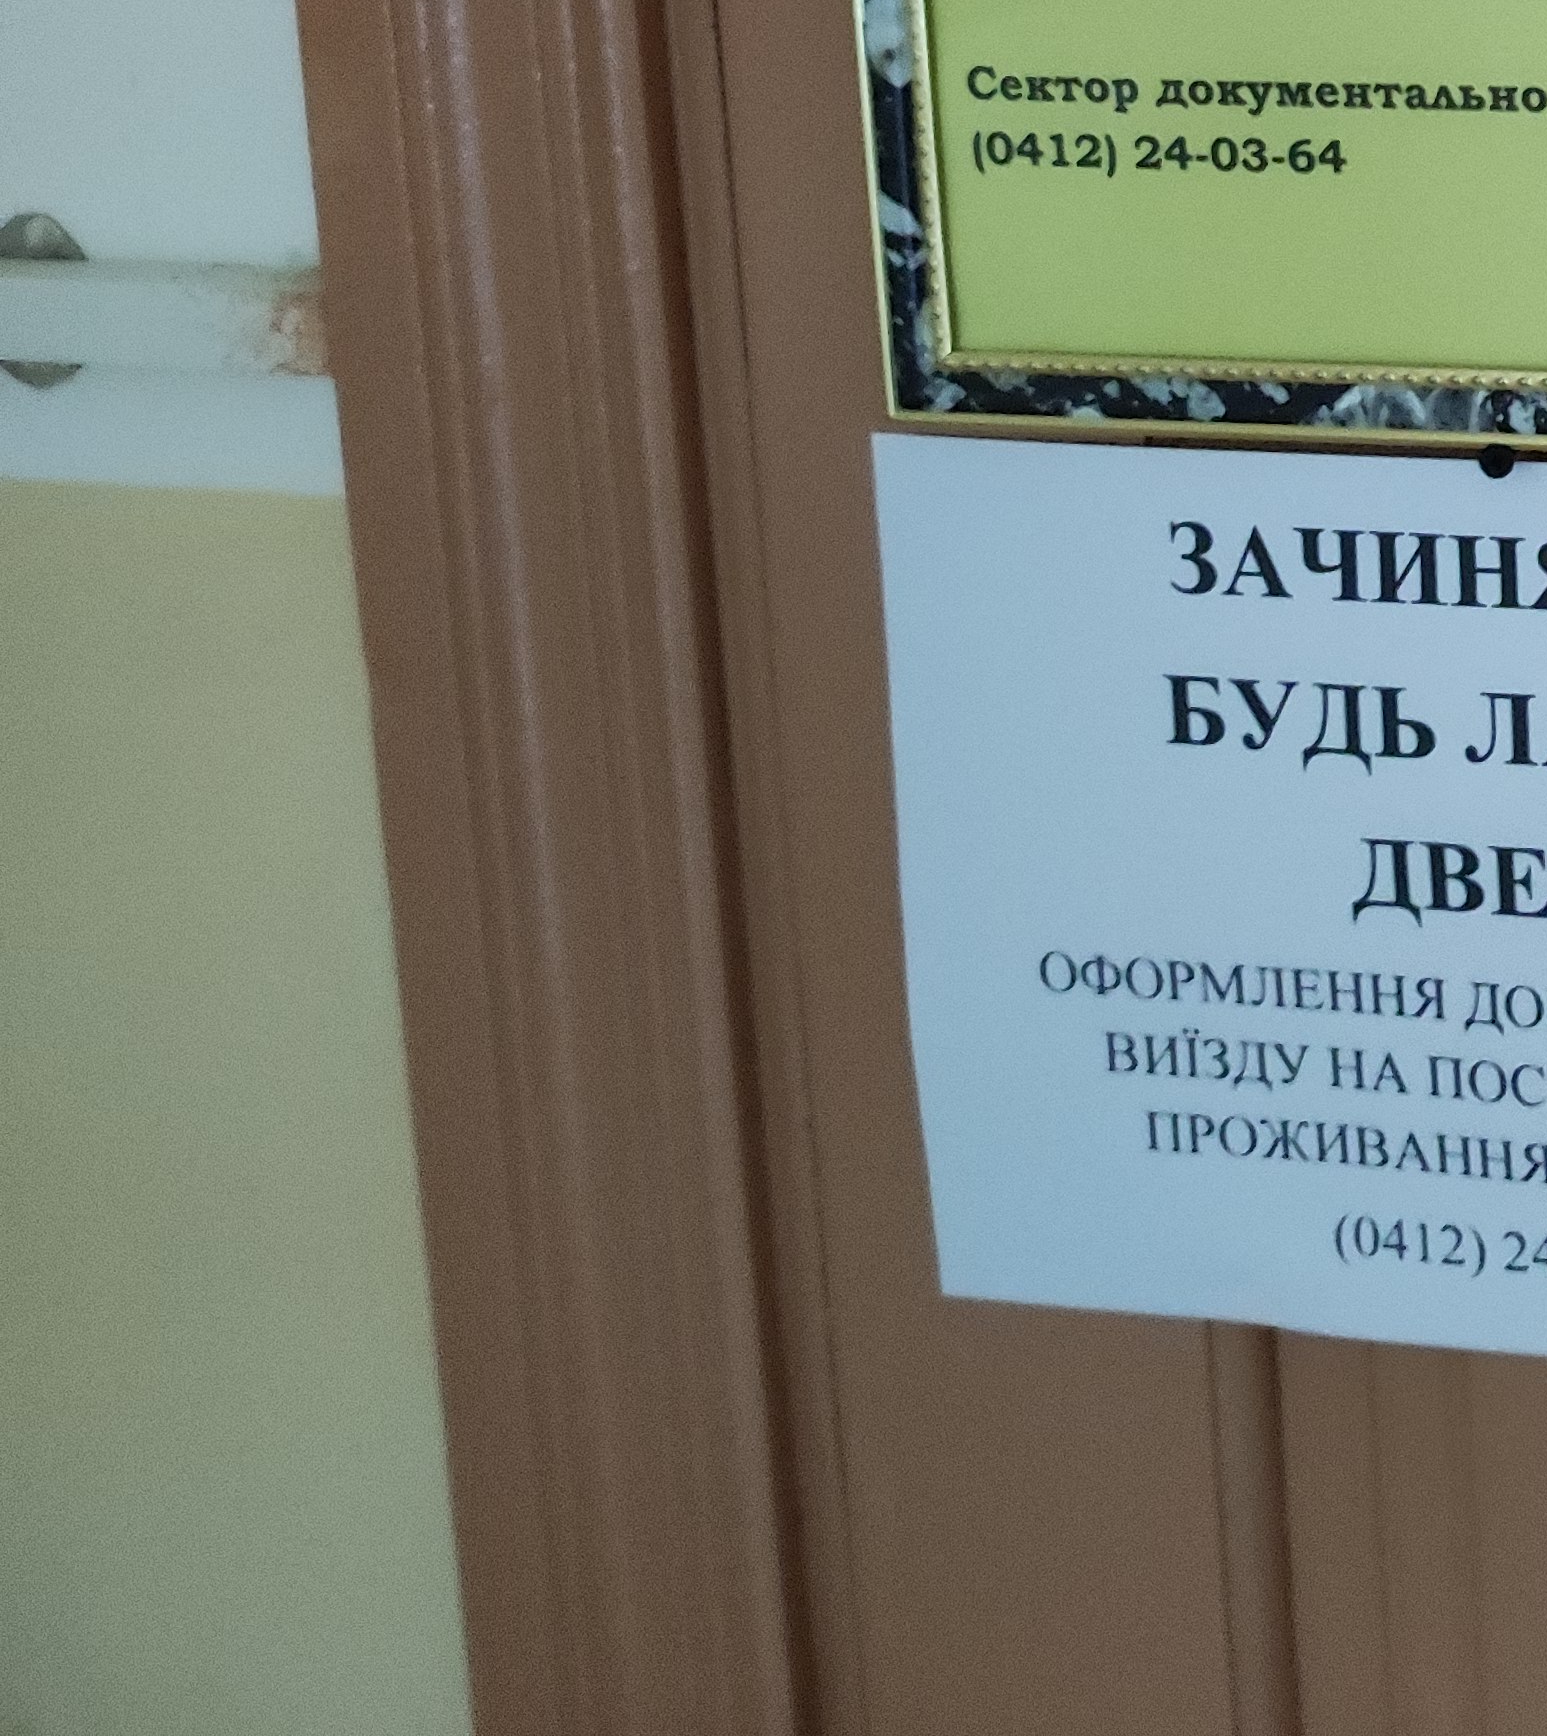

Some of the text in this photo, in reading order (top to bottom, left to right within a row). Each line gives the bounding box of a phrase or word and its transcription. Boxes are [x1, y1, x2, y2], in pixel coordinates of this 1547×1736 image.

[966, 65, 1139, 115] Сектор
[972, 130, 1348, 179] (0412) 24-03-64
[1162, 673, 1437, 776] БУДЬ
[1038, 950, 1446, 1021] ОФОРМЛЕННЯ
[1105, 1027, 1310, 1091] ВИЇЗДУ
[1329, 1046, 1408, 1095] НА
[1334, 1215, 1487, 1277] (0412)
